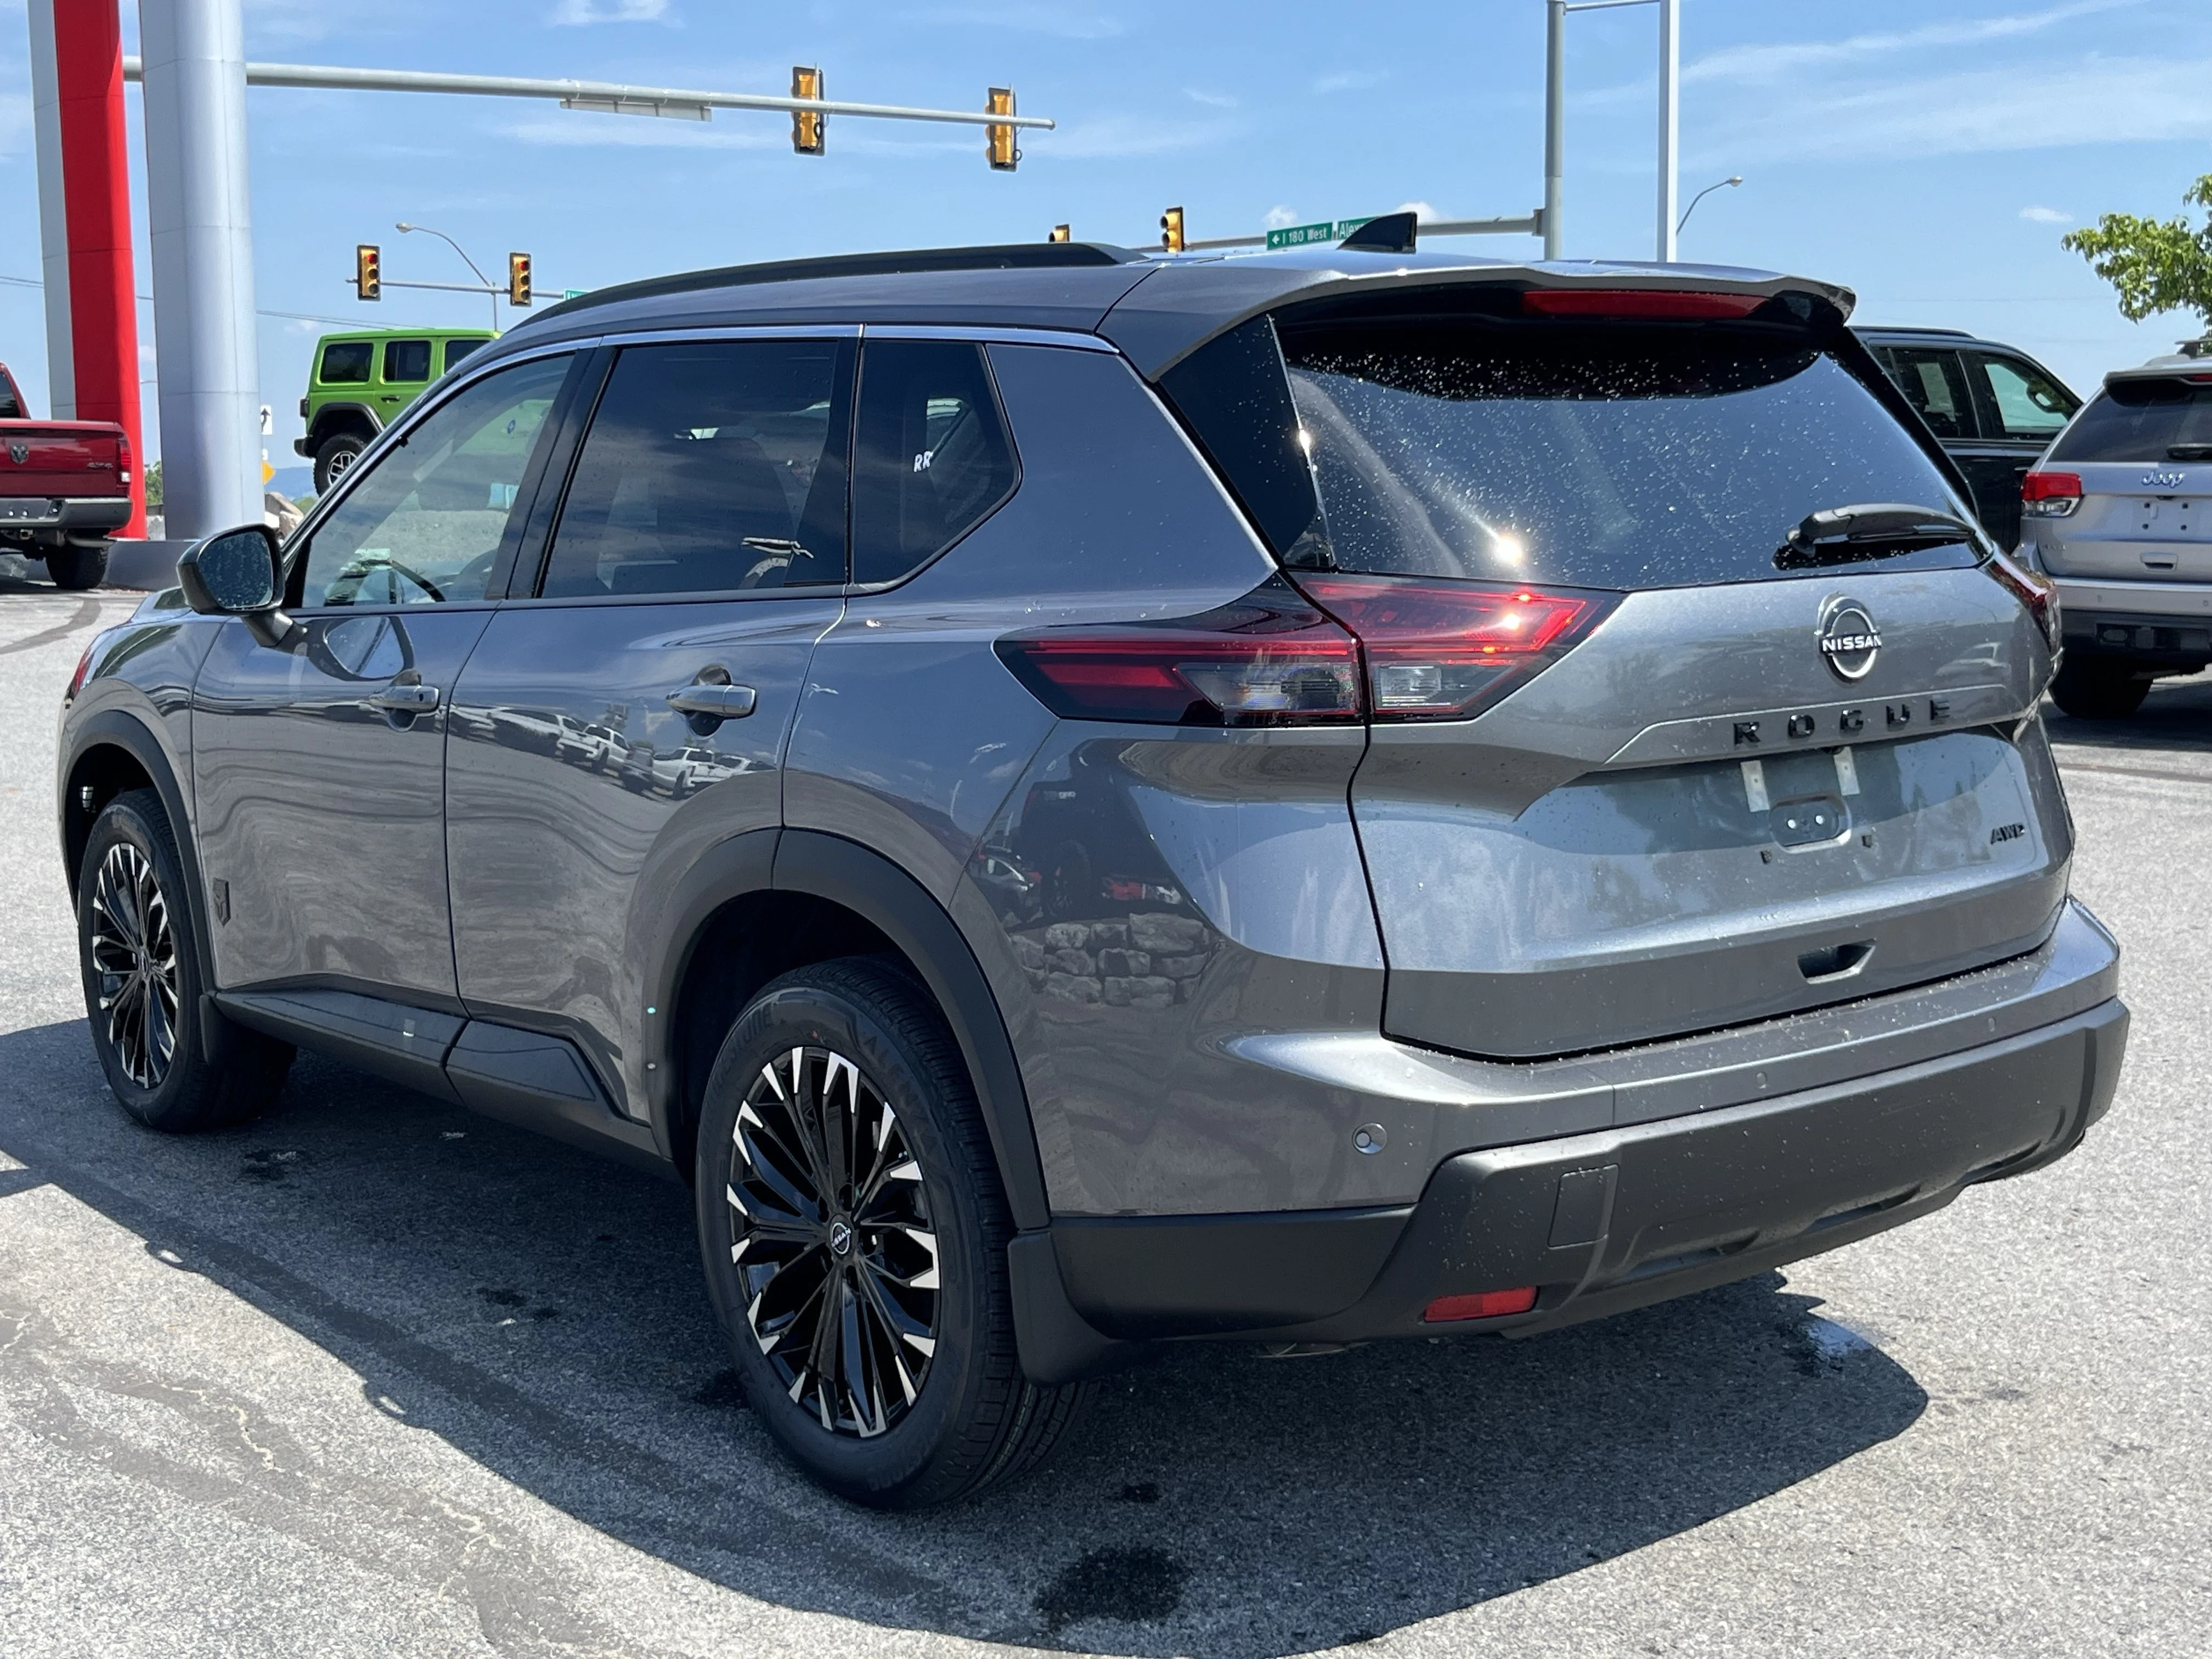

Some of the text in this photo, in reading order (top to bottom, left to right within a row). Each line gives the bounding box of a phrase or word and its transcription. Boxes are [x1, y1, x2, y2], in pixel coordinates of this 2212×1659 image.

[1289, 230, 1304, 243] 180
[1307, 227, 1327, 241] West
[913, 451, 931, 472] RR
[2141, 471, 2186, 489] Jeep
[1822, 635, 1882, 652] NISSAN
[1733, 699, 1950, 745] ROGUE
[1990, 823, 2024, 844] AWD
